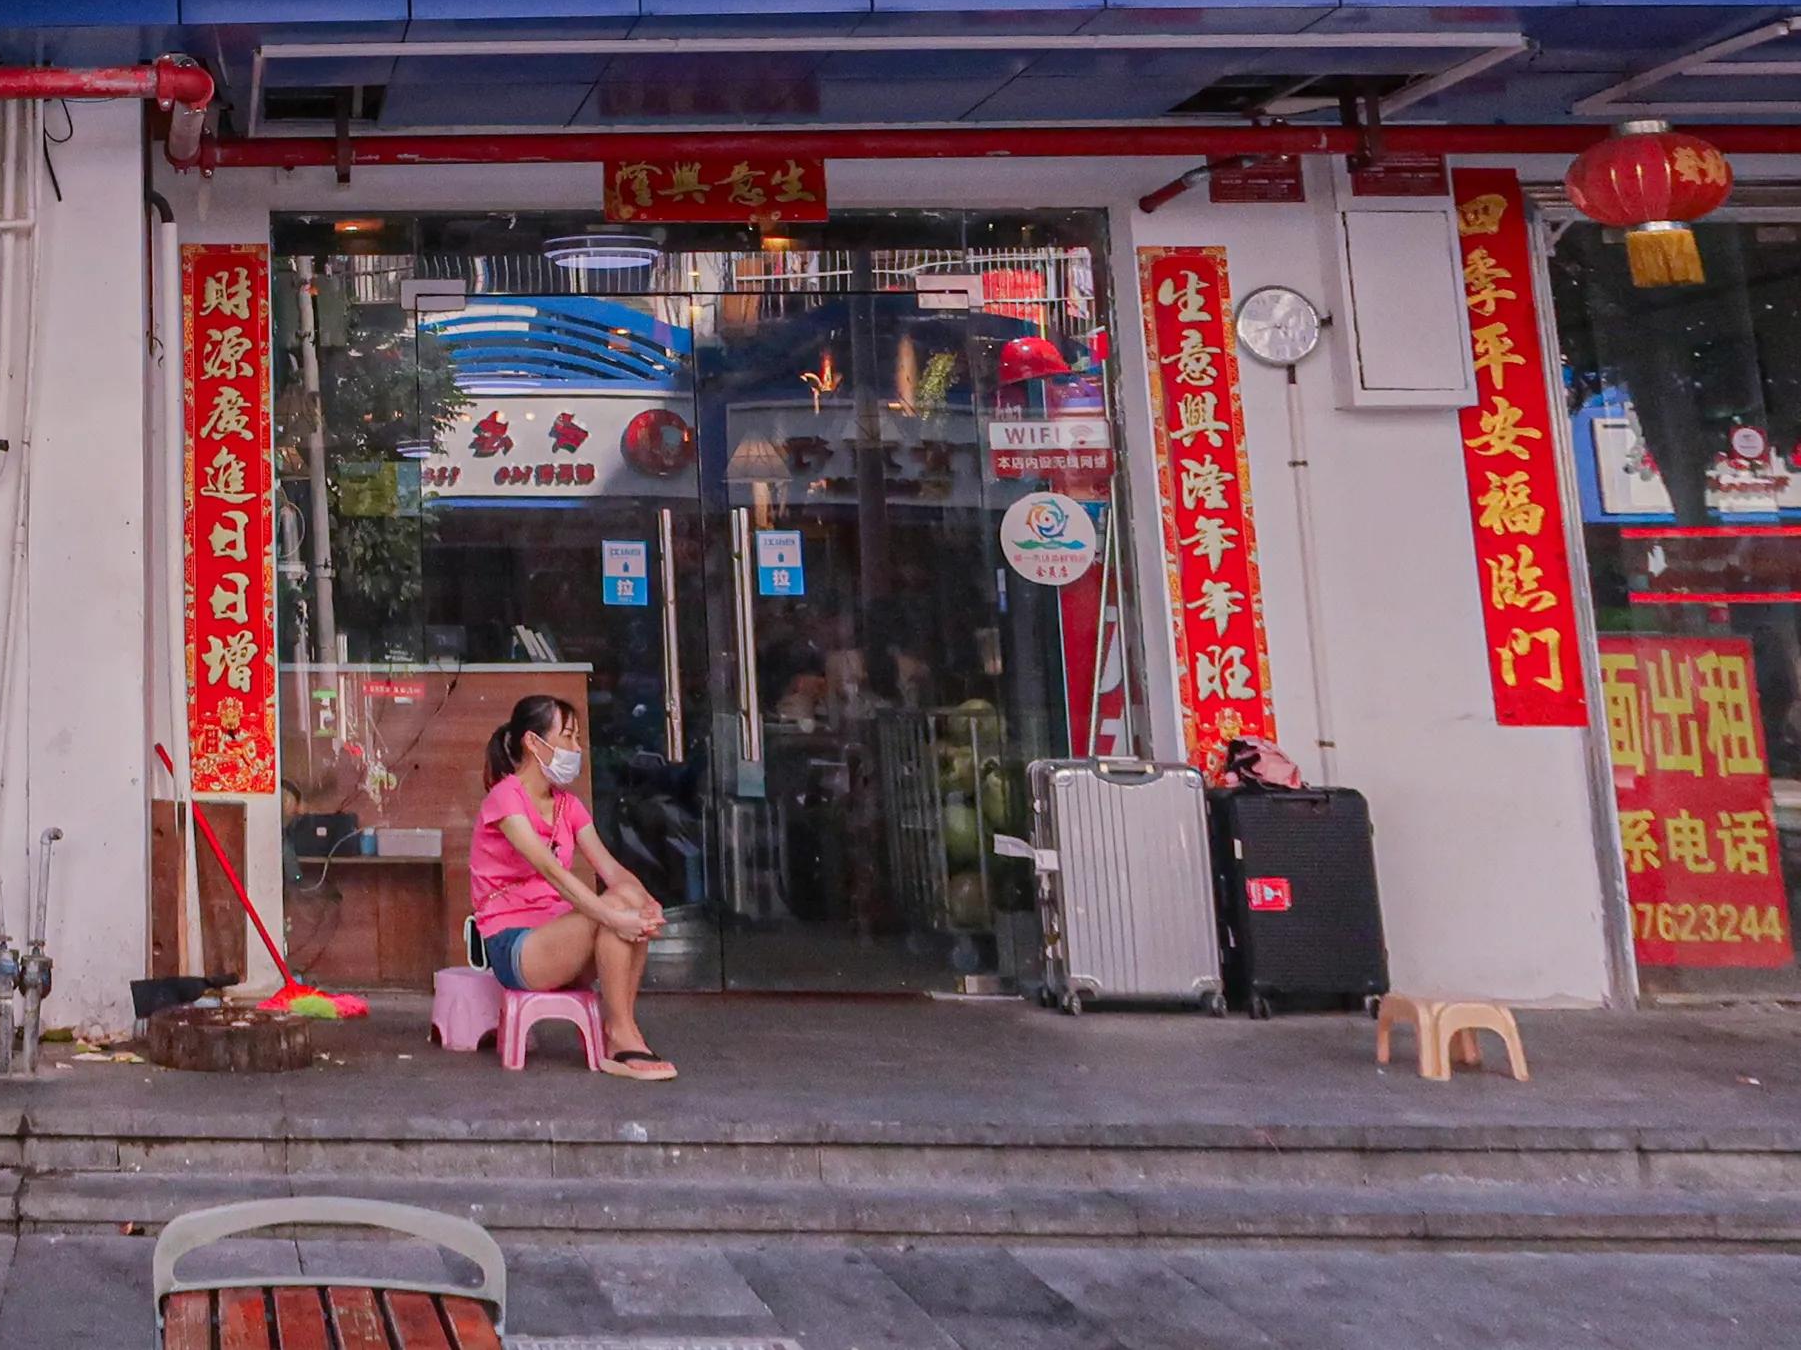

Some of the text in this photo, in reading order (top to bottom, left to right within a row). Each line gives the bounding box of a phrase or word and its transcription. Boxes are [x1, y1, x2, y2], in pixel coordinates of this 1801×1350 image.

[199, 266, 258, 695] 財源廣進日日增
[997, 455, 1107, 470] 本店内设无线网络
[1004, 427, 1060, 445] WIFI
[1157, 269, 1257, 702] 生意興隆年年旺
